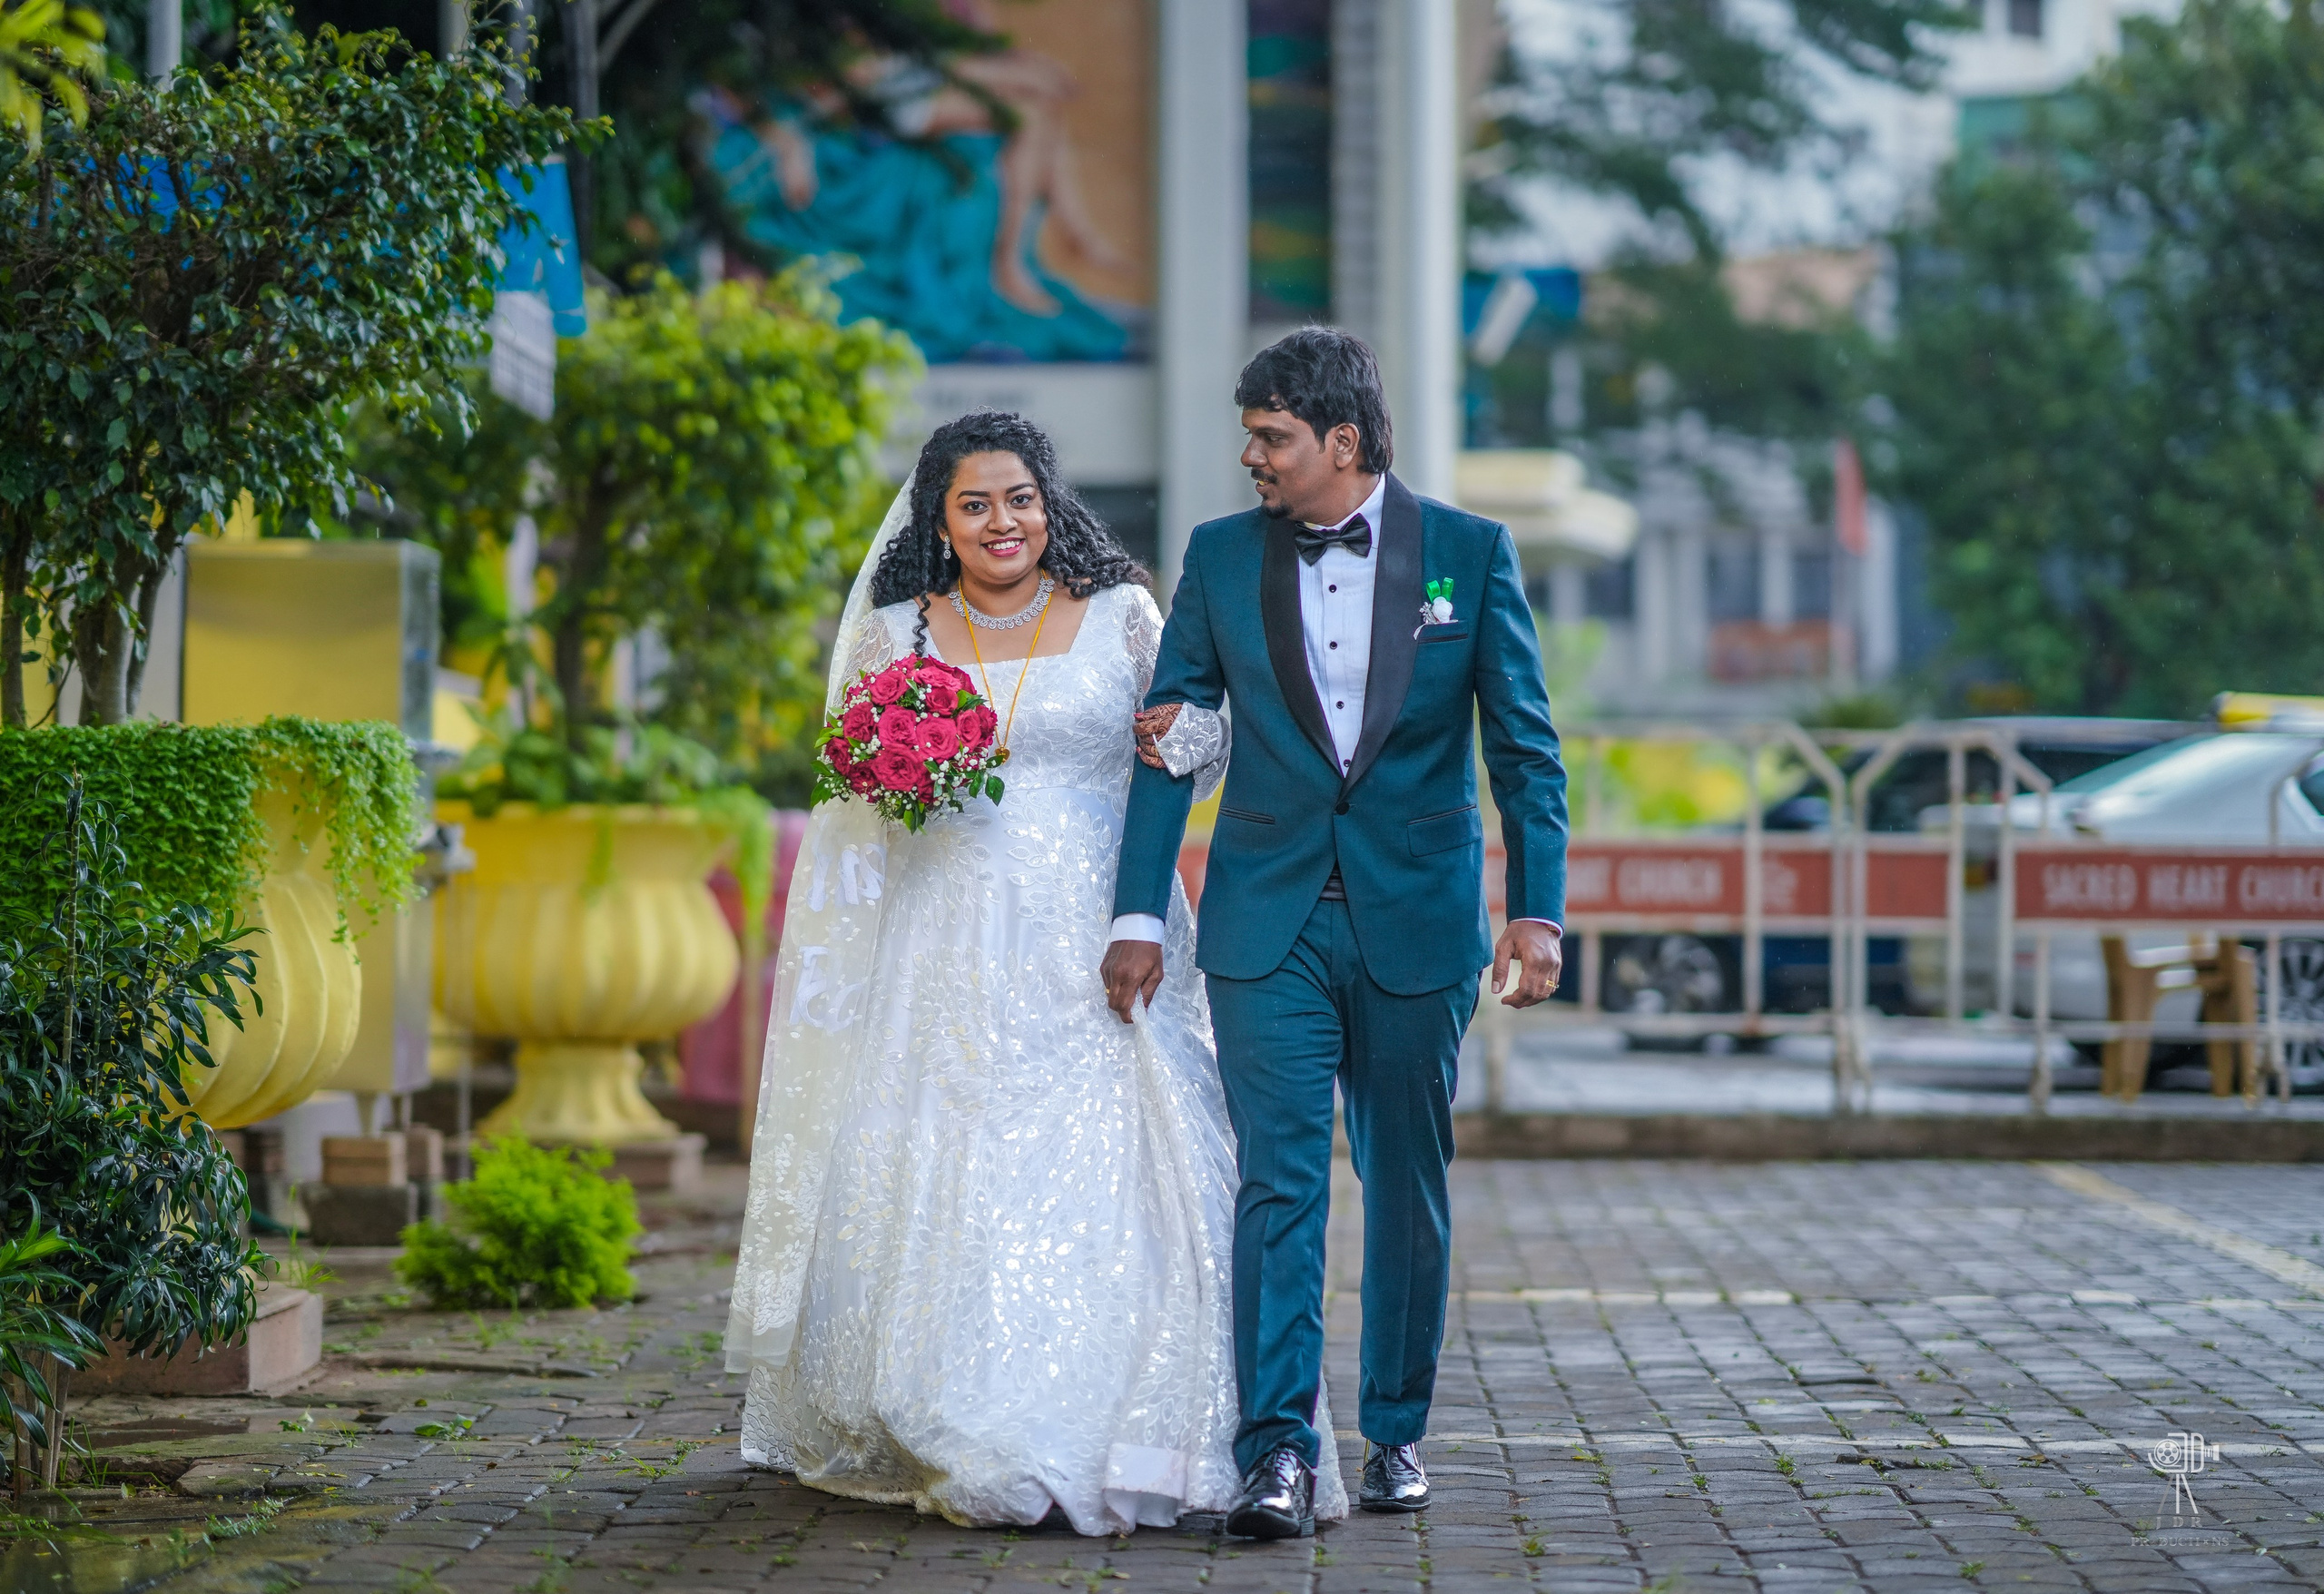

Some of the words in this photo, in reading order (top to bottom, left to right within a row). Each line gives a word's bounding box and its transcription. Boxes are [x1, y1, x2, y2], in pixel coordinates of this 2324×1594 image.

[2042, 863, 2136, 911] SACRED
[2147, 863, 2229, 912] HEART
[2239, 864, 2324, 913] CHURC
